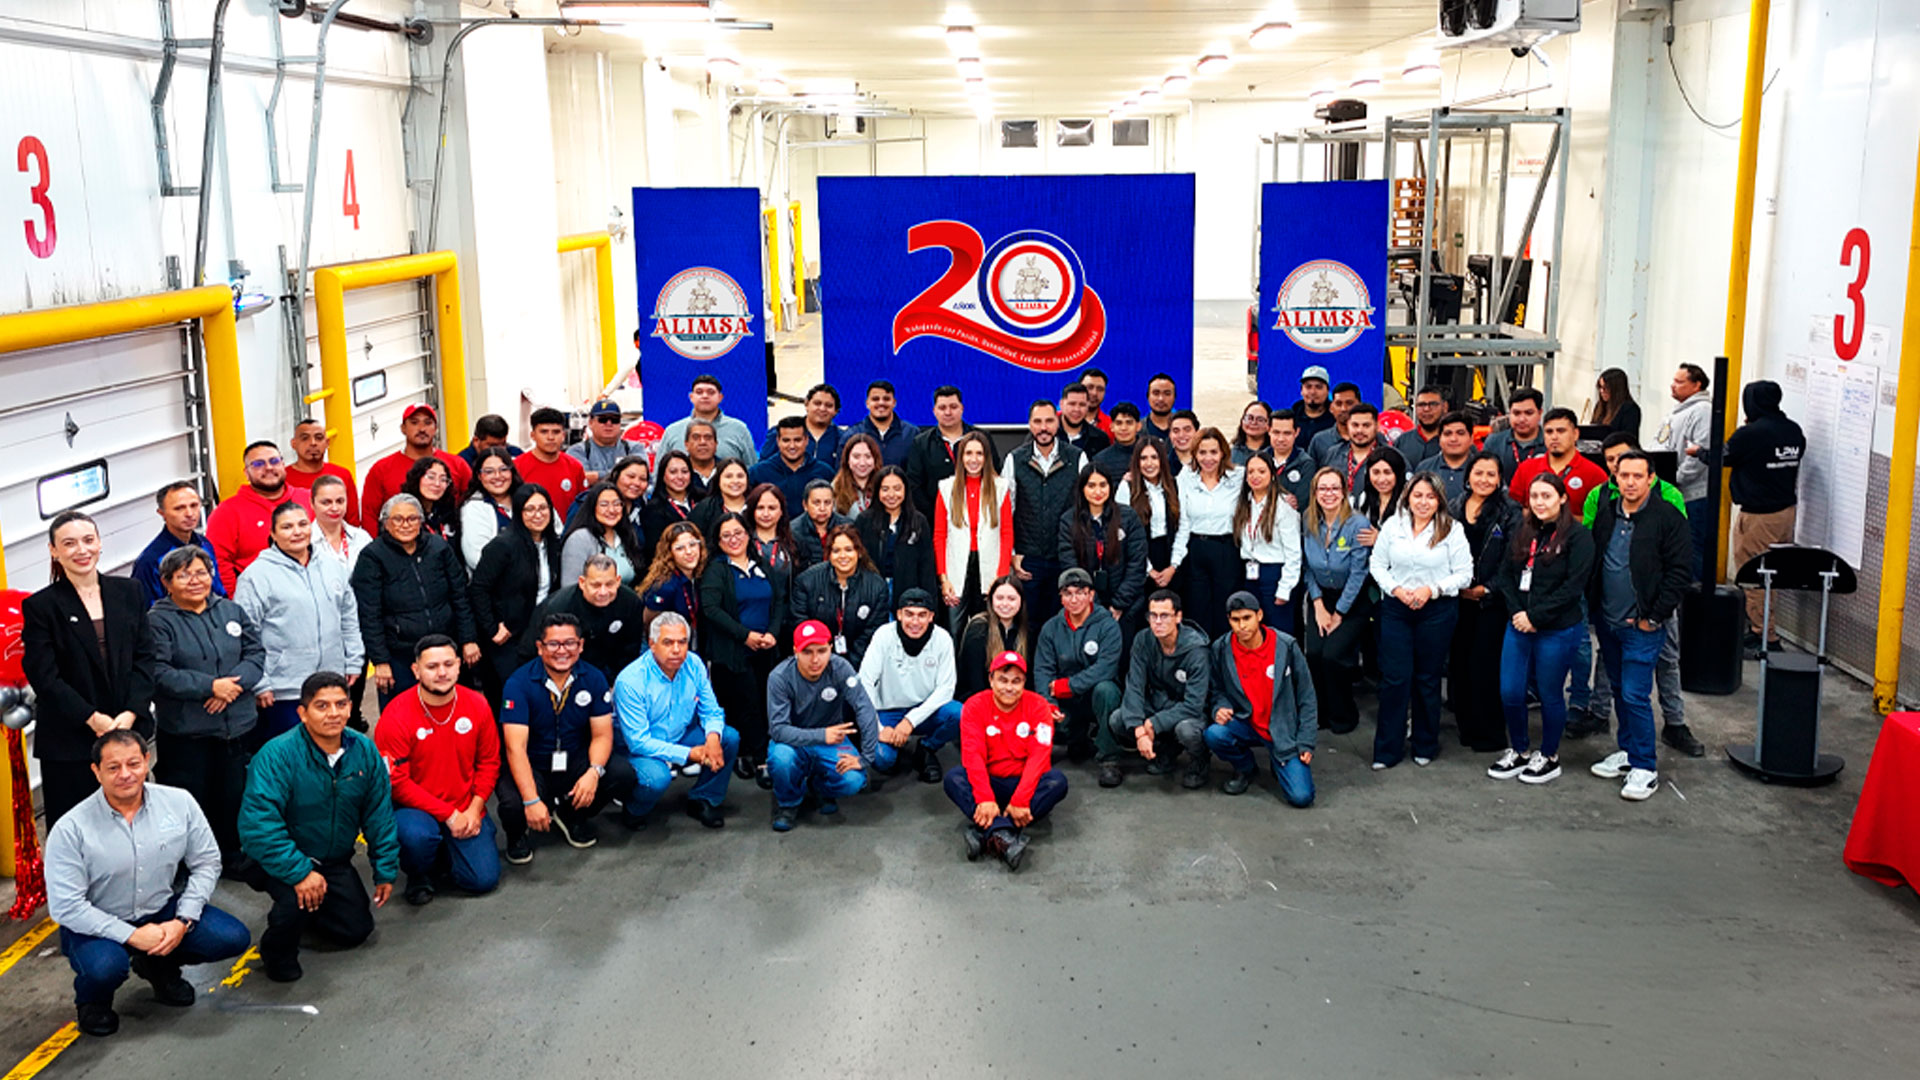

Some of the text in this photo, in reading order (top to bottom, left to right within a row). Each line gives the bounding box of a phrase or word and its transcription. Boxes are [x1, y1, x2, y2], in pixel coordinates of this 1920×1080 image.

[16, 135, 57, 259] 3
[342, 149, 360, 230] 4
[1013, 302, 1049, 310] ALIMSA
[1277, 309, 1371, 327] ALIMSA
[1833, 227, 1871, 361] 3
[654, 317, 749, 334] ALIMSA
